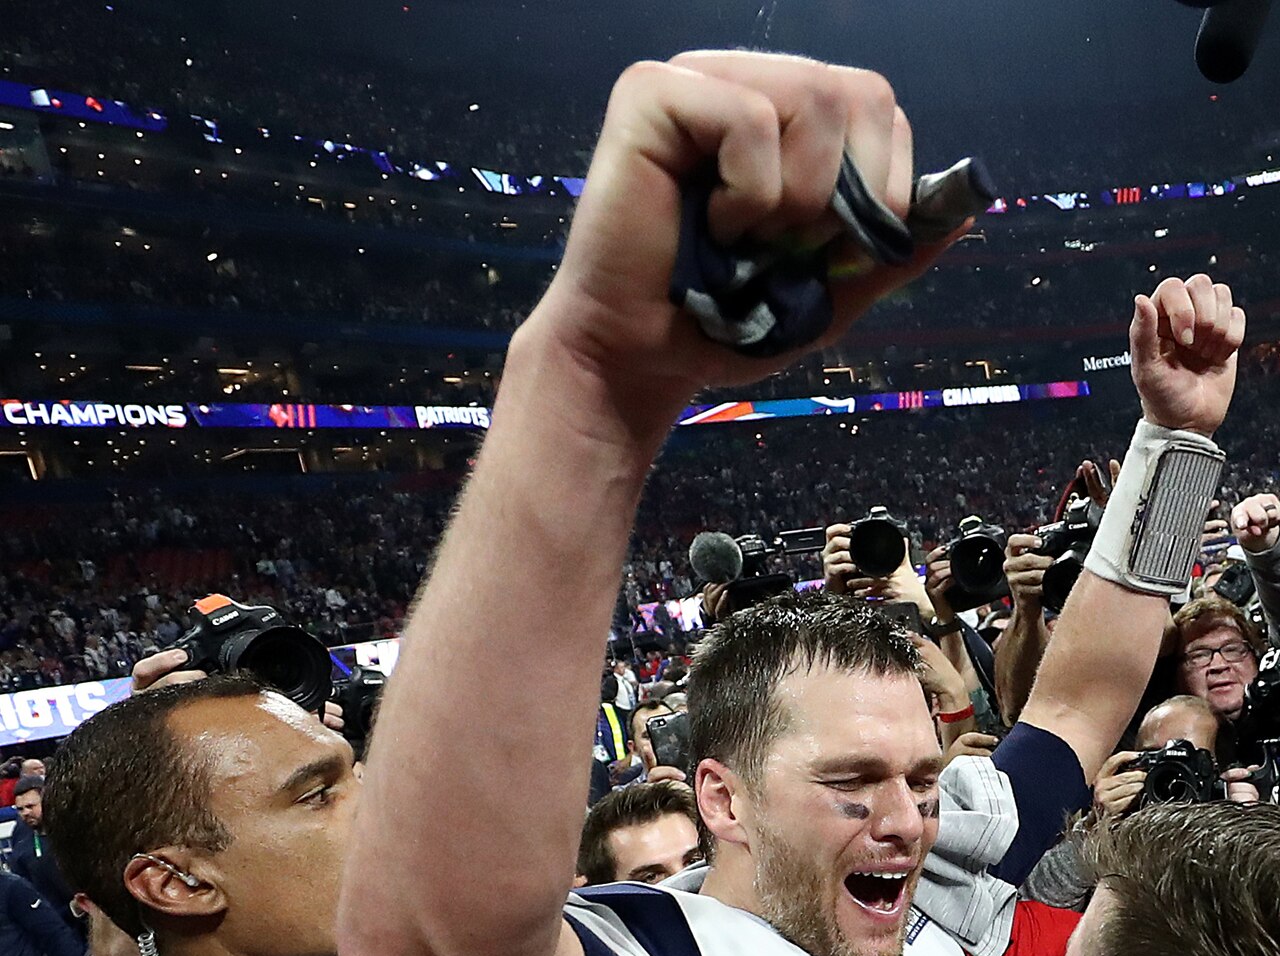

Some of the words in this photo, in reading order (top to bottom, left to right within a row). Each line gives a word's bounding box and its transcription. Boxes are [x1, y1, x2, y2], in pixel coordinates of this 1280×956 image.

[942, 385, 1021, 406] CHAMPIONS
[3, 404, 187, 426] CHAMPIONS
[415, 406, 490, 428] PATRIOTS
[0, 682, 109, 732] IOTS
